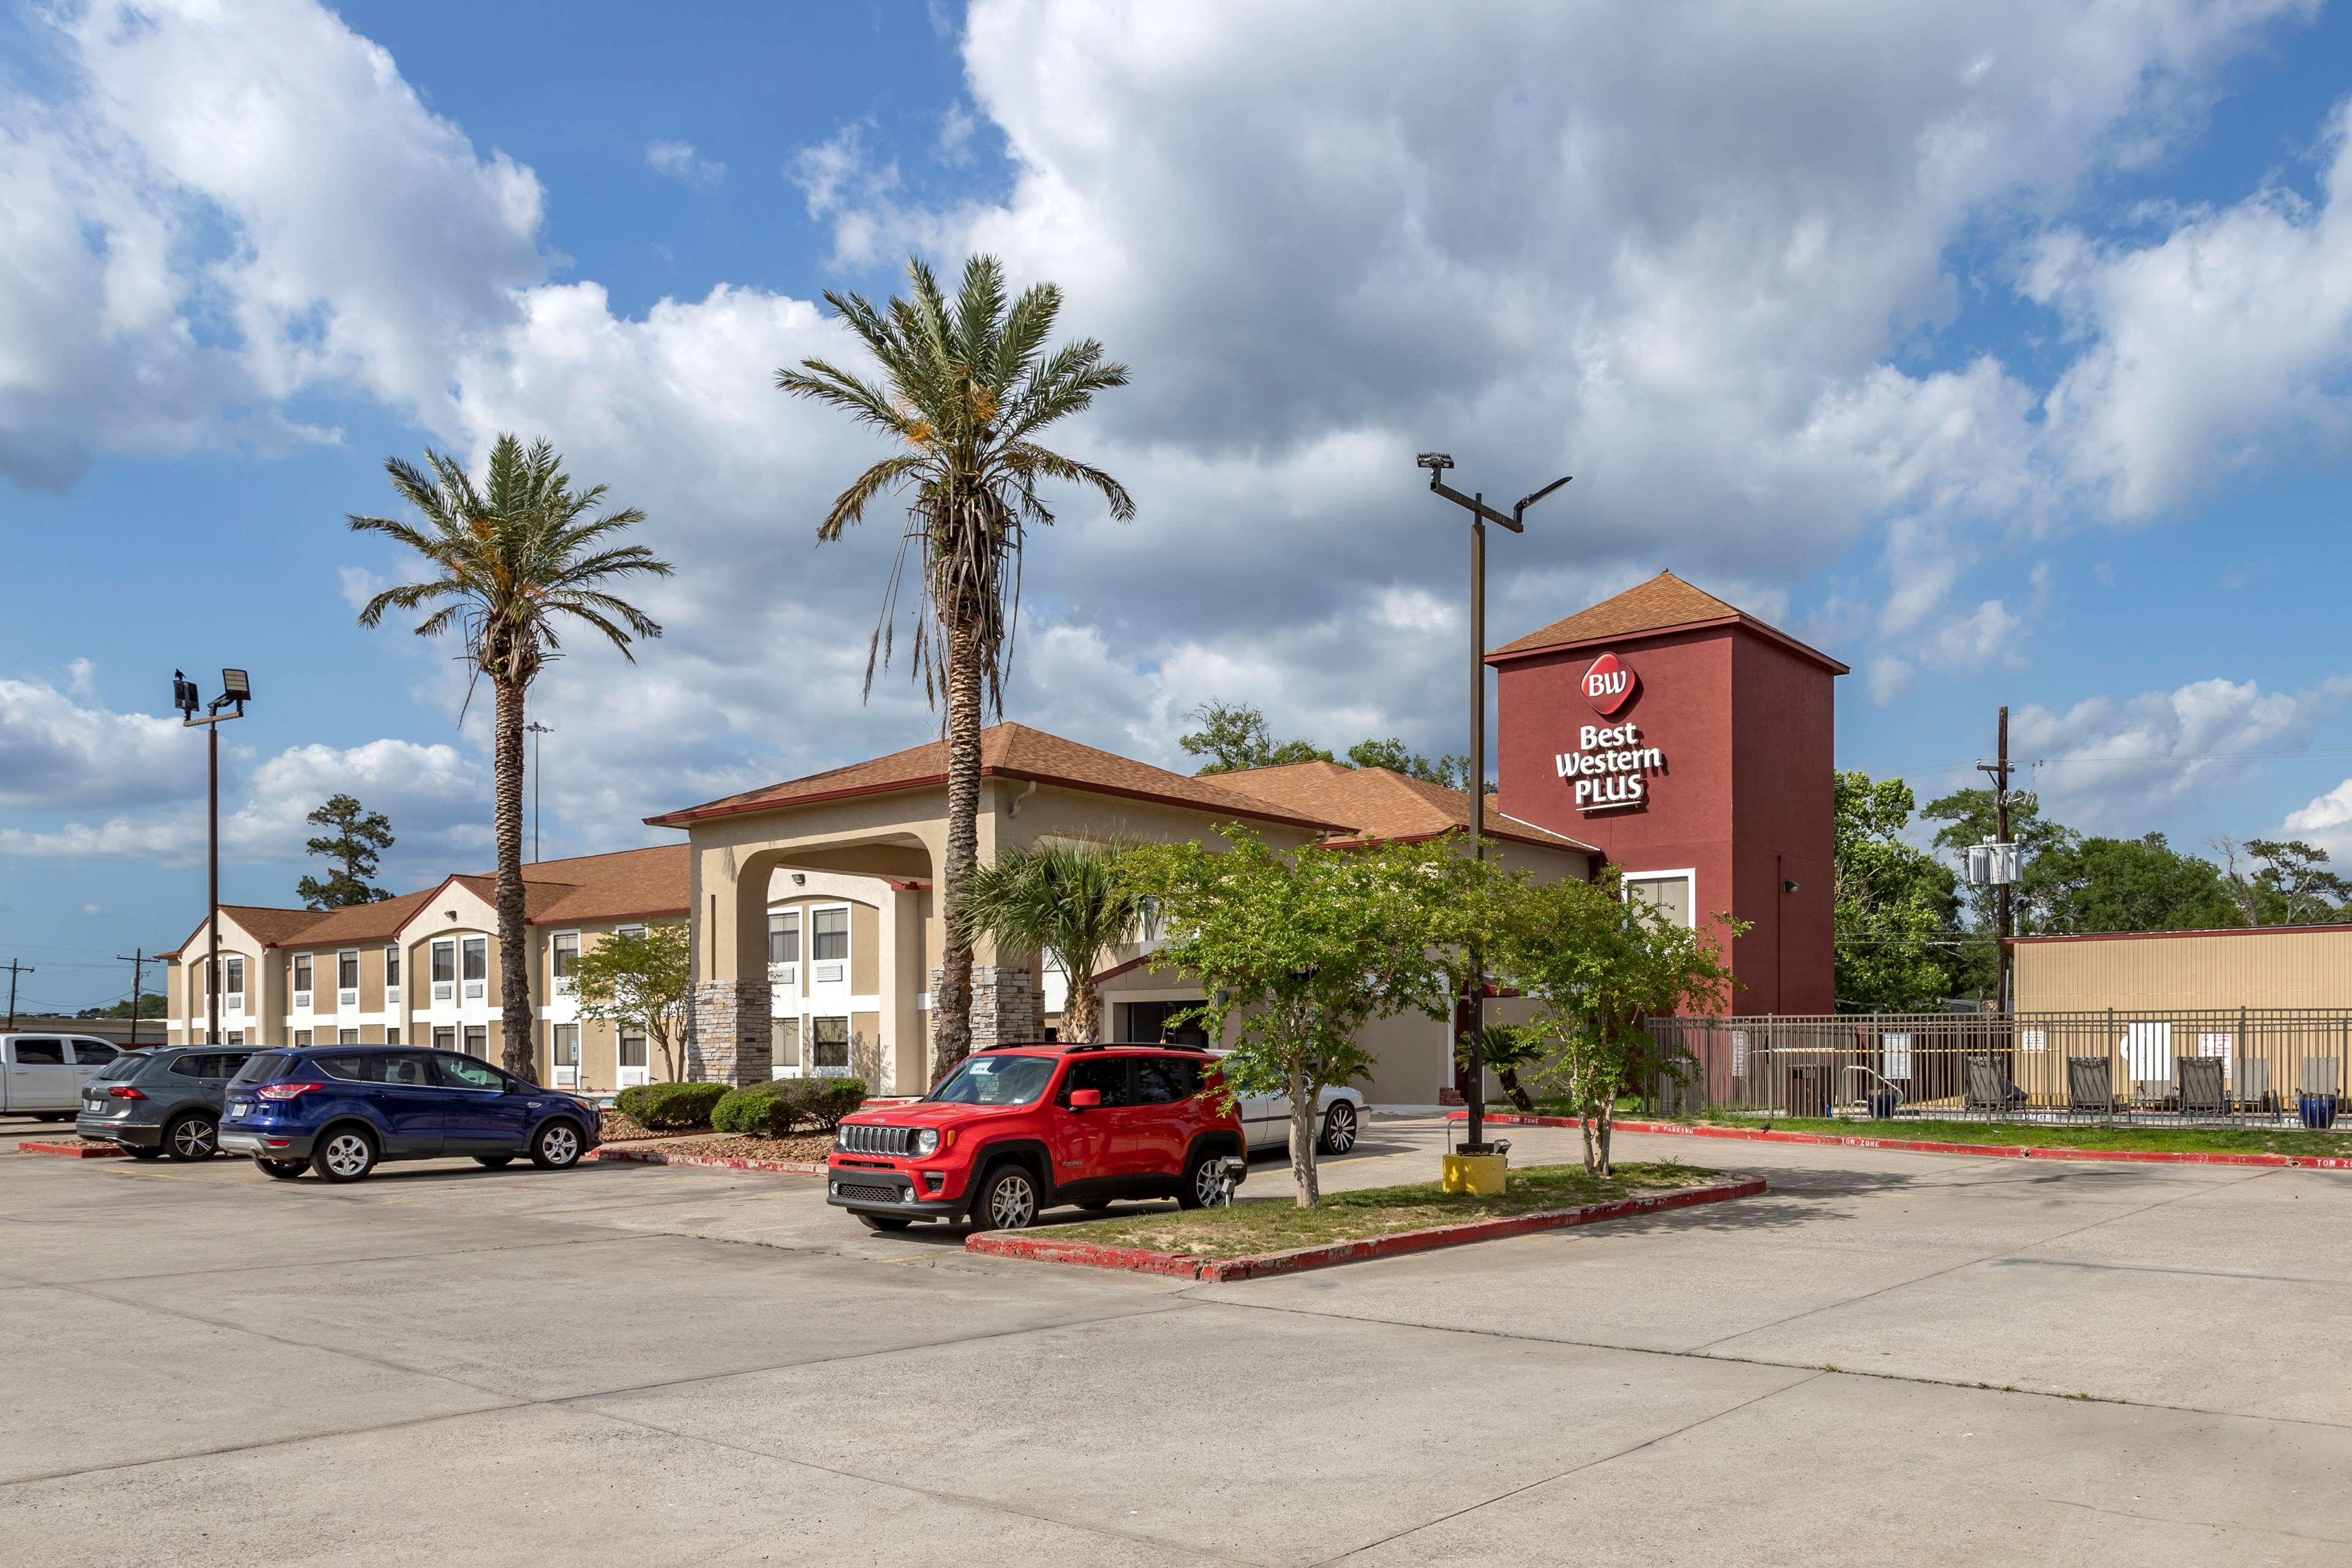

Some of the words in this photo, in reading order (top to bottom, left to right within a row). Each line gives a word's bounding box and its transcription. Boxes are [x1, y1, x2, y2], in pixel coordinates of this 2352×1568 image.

[1589, 670, 1627, 696] BW
[1580, 722, 1638, 750] Best
[1555, 747, 1663, 777] Western
[1575, 774, 1643, 804] PLUS
